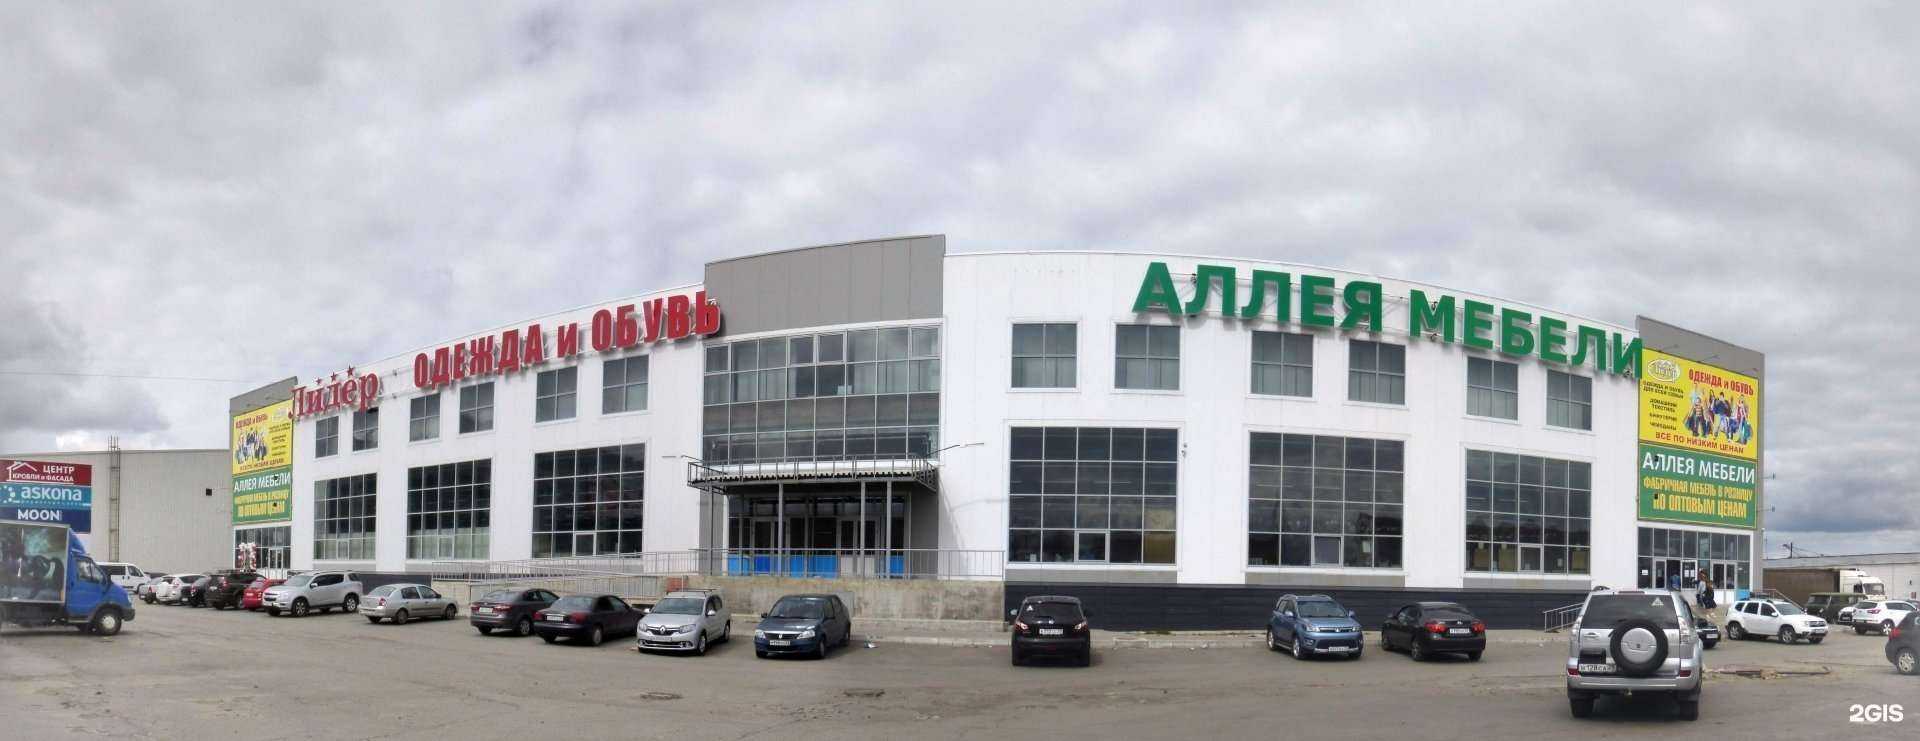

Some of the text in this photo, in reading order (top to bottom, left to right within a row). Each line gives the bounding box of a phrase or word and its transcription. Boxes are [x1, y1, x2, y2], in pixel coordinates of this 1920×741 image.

[1132, 261, 1644, 379] АЛЛЕЯ МЕБЕЛИ
[413, 290, 721, 390] ОДЕЖДА и ОБУВЬ
[1688, 367, 1722, 389] ОДЕЖДА
[1730, 378, 1754, 396] ОБУВЬ
[288, 371, 380, 420] Лидер
[1673, 434, 1684, 443] ПО
[1687, 437, 1717, 449] НИЗКИМ
[43, 465, 75, 474] ЦЕНТР
[1642, 452, 1755, 485] АЛЛЕЯ МЕБЕЛИ
[21, 486, 82, 501] askona
[234, 472, 291, 493] АЛЛЕЯ МЕБЕЛИ
[1643, 476, 1688, 493] ФАБРИЧНАЯ
[1689, 481, 1717, 497] МЕБЕЛЬ
[17, 509, 60, 520] MOON
[1669, 494, 1715, 515] ОПТОВЫМ
[1717, 499, 1747, 518] ЦЕНАМ
